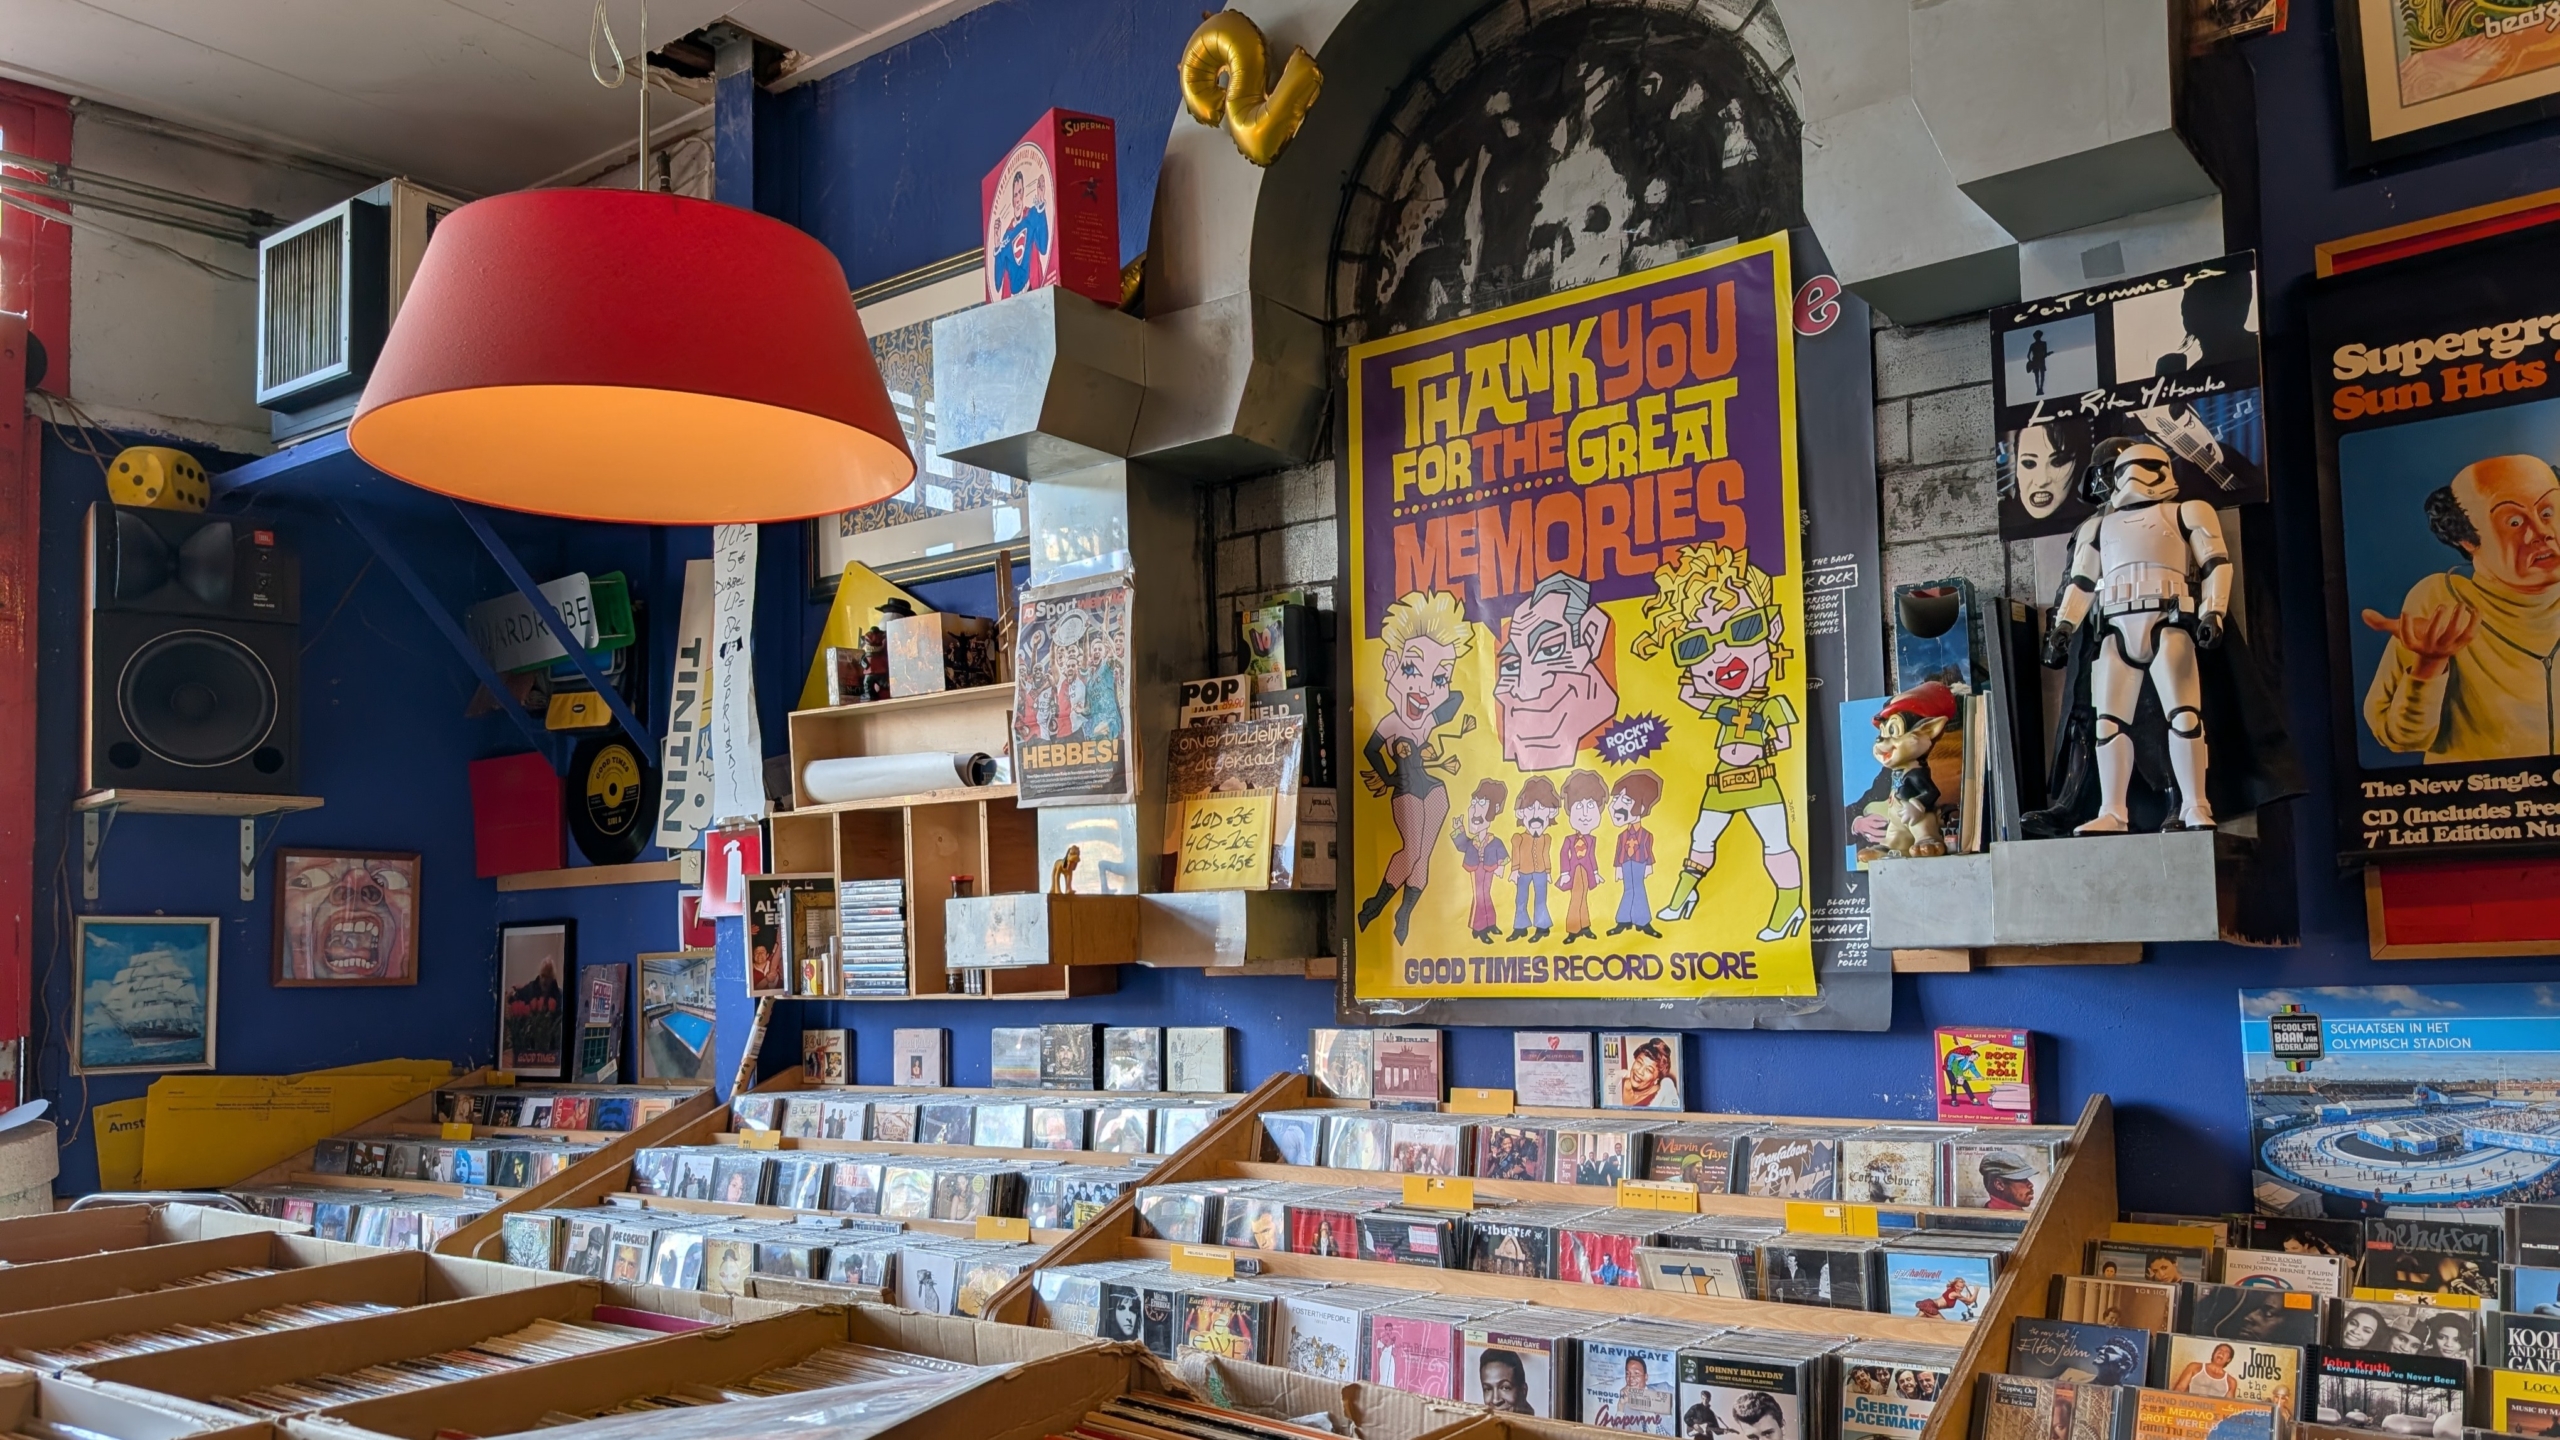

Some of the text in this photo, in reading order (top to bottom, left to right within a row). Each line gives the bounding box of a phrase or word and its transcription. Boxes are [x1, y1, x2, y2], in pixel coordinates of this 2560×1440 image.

[1064, 120, 1111, 137] SUPERMAN
[2333, 313, 2560, 381] Supergr
[1392, 316, 1599, 449] THANK
[2333, 360, 2548, 421] Sun Hits
[1392, 378, 1738, 502] FOR THE GREAT
[1393, 459, 1745, 600] MEMORIES
[1812, 553, 1855, 566] THE BAND
[1818, 571, 1853, 586] ROCK
[1807, 601, 1840, 611] MASON
[474, 596, 591, 652] WARDRBE
[1180, 679, 1239, 707] POP
[1194, 705, 1219, 713] JAAR
[662, 638, 702, 833] TINTIN
[1606, 720, 1654, 749] ROCK'N
[1617, 735, 1648, 757] ROLF
[1022, 739, 1119, 770] HEBBES!
[2360, 771, 2548, 798] The New Single.
[2362, 809, 2399, 826] CD
[2403, 803, 2512, 827] (Includes
[2388, 827, 2429, 845] Ltd
[2433, 823, 2522, 843] Edition
[1827, 898, 1866, 907] BLONDIE
[1828, 906, 1871, 915] COSTELLO
[1827, 923, 1864, 935] WAVE
[1404, 951, 1758, 985] GOOD TIMES RECORD STORE
[1837, 959, 1868, 967] POLICE
[1660, 1002, 1674, 1010] DIO
[2281, 1023, 2317, 1032] COOLSTE
[2330, 1022, 2450, 1035] SCHAATSEN IN HET
[2274, 1032, 2304, 1043] BAAN
[2331, 1037, 2472, 1049] OLYMPISCH STADION
[1604, 1043, 1619, 1058] ELLA
[2275, 1043, 2318, 1051] NEDERLAND
[1985, 1051, 2018, 1061] ROCK
[1986, 1068, 2018, 1077] ROLL
[1656, 1137, 1728, 1160] Marvin Gaye
[1764, 1161, 1792, 1183] Bus
[1427, 1178, 1435, 1193] F
[1883, 1173, 1921, 1188] Glover
[611, 1230, 649, 1246] JOE COCKER
[2277, 1256, 2303, 1264] ROOMS
[2252, 1264, 2270, 1272] JOHN
[2279, 1267, 2304, 1275] BERNIE
[1234, 1302, 1251, 1311] Fire
[1051, 1305, 1089, 1324] DOOBIE
[1497, 1338, 1523, 1347] MARVIN
[1523, 1340, 1540, 1349] GAYE
[2017, 1338, 2057, 1355] Elton
[1589, 1344, 1669, 1362] MARVIN GAYE
[2249, 1347, 2276, 1368] Tom
[2508, 1346, 2536, 1358] AND
[1705, 1365, 1784, 1380] JOHNNY HALLYDAY
[2238, 1361, 2282, 1381] Jones
[2322, 1357, 2391, 1373] John Kruth
[1731, 1376, 1753, 1384] CLASSIC
[2326, 1364, 2456, 1385] Everywhere You've Never Been
[2248, 1380, 2267, 1391] the
[1587, 1388, 1625, 1399] THROUGH
[1597, 1396, 1614, 1404] THE
[2237, 1390, 2262, 1400] lead
[1855, 1396, 1909, 1416] GERRY
[2141, 1393, 2216, 1411] GRAND MONDE
[1595, 1404, 1663, 1428] Grapevine
[2139, 1412, 2219, 1431] GROTE WERELD
